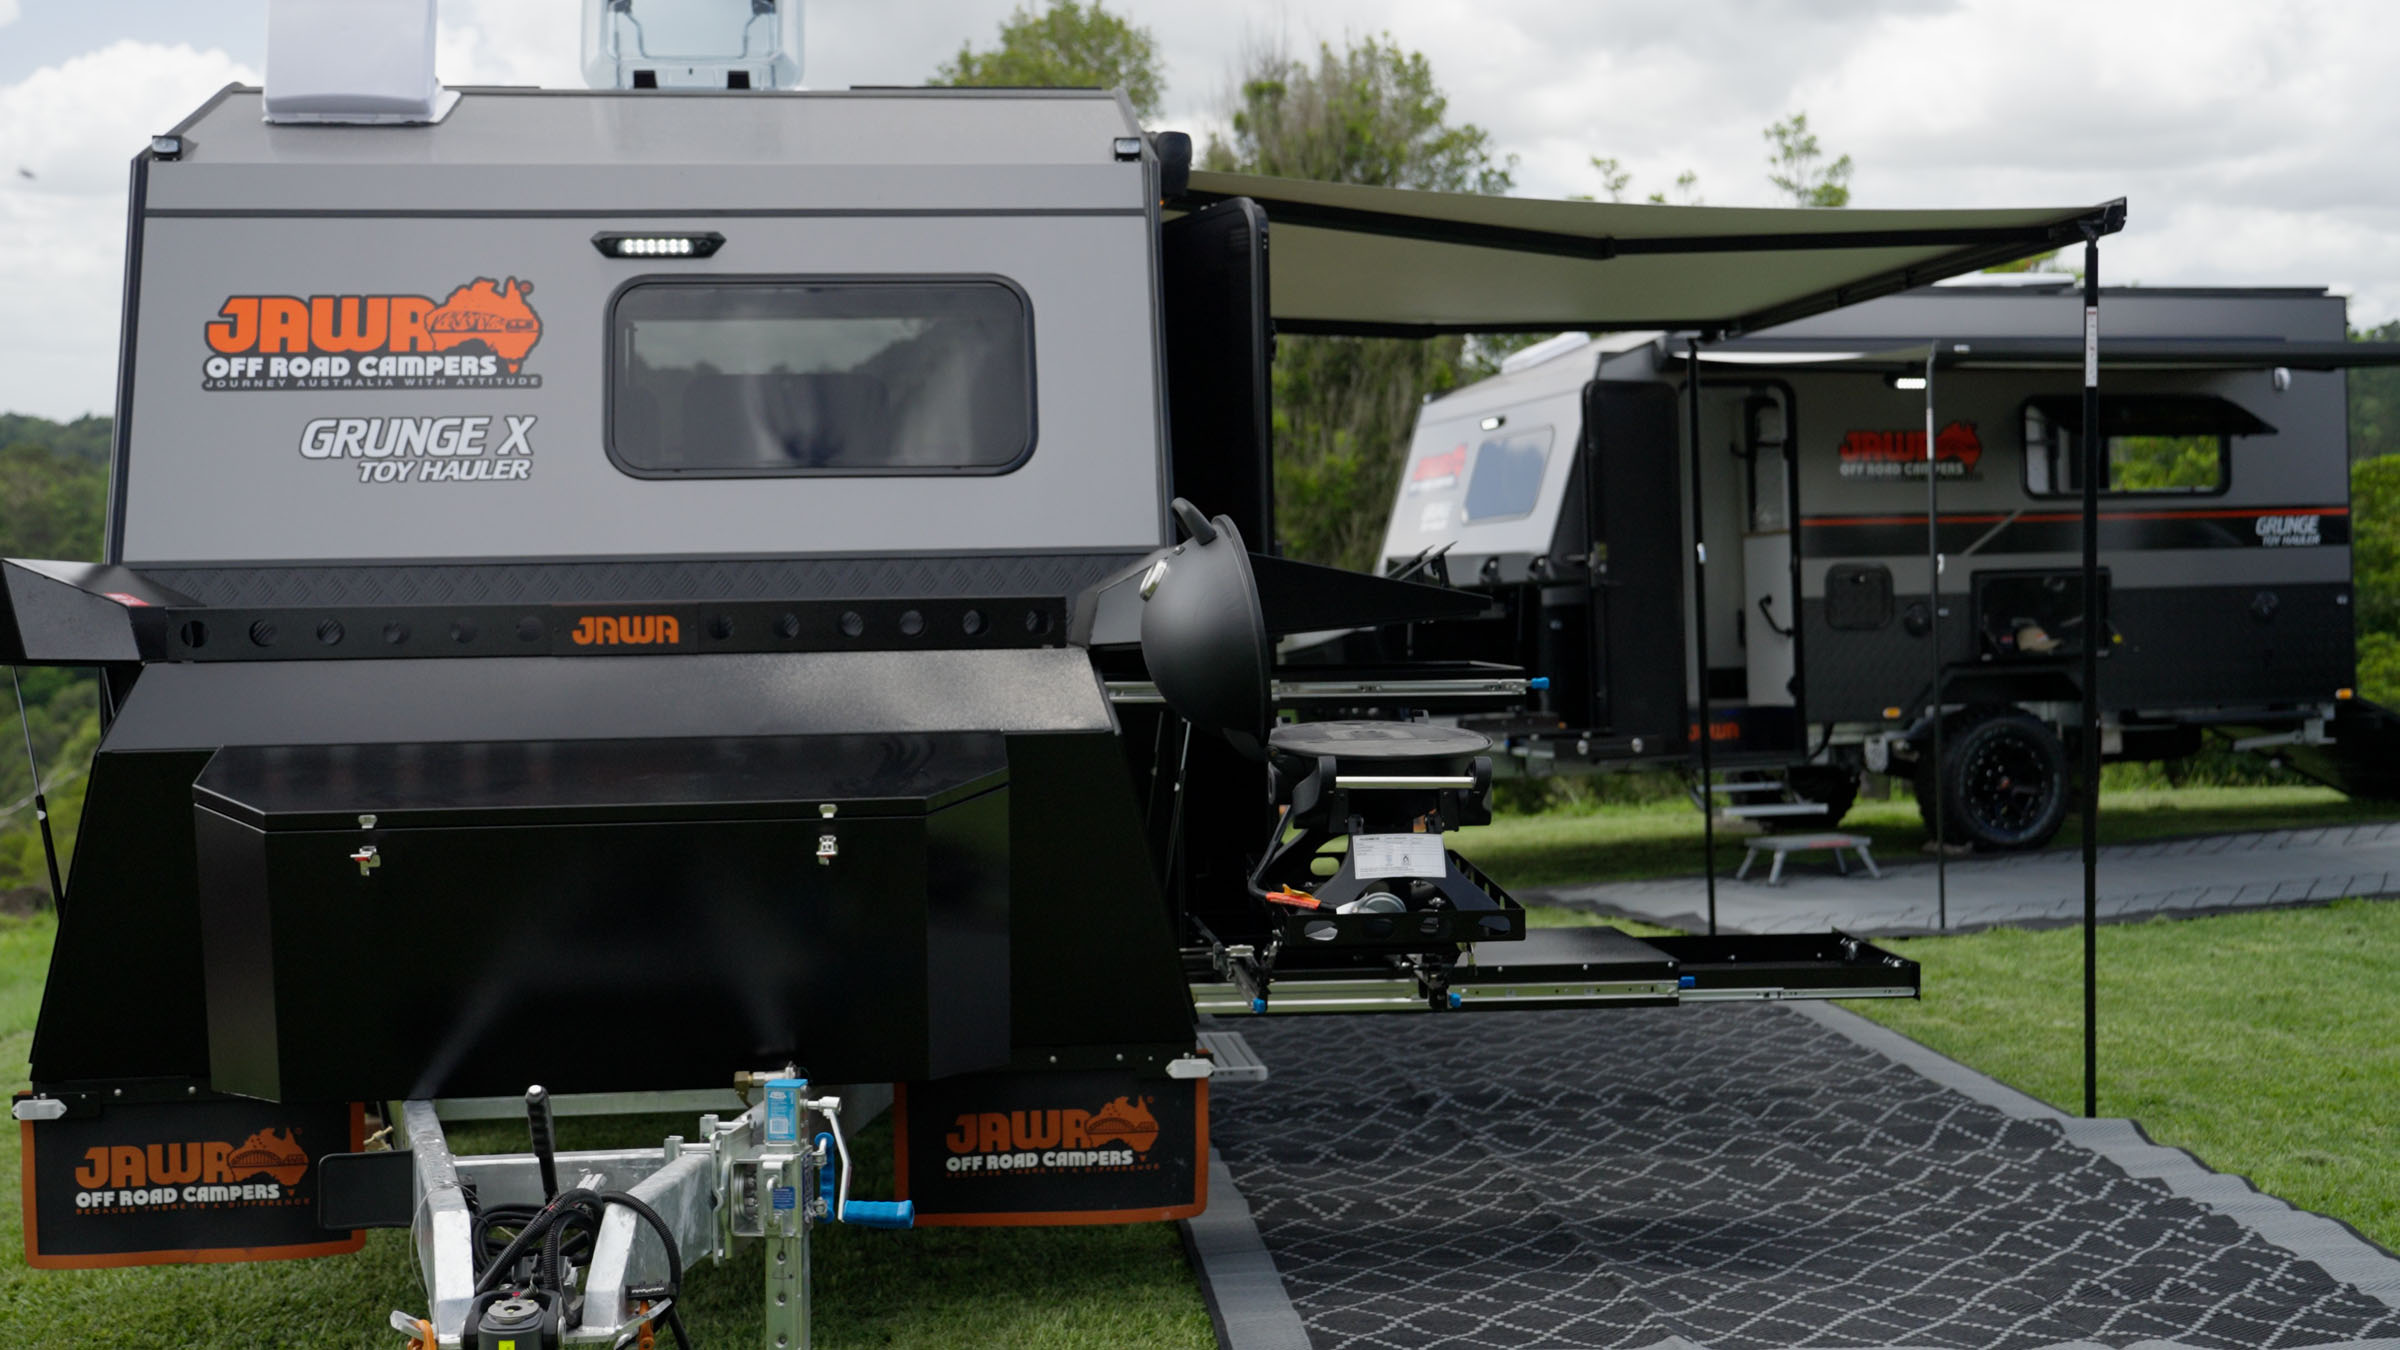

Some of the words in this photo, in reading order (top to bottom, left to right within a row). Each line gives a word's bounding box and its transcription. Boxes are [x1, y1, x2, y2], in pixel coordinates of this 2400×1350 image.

[206, 296, 437, 354] JAWA
[205, 355, 265, 379] OFF
[269, 355, 351, 378] ROAD
[357, 354, 498, 378] CAMPERS
[204, 378, 287, 388] JOURNEY
[296, 378, 394, 388] AUSTRALIA
[404, 377, 446, 387] WITH
[456, 376, 539, 387] ATTITUDE
[300, 417, 492, 459] GRUNGE
[497, 415, 537, 456] X
[358, 460, 415, 483] TOY
[418, 459, 531, 481] HAULER
[2255, 515, 2321, 536] GRUNGE
[572, 615, 680, 645] JAWA
[1688, 723, 1740, 741] JWA
[946, 1109, 1091, 1154] JAWA
[75, 1142, 235, 1189] JAWA
[946, 1156, 983, 1172] OFF
[986, 1152, 1039, 1170] ROAD
[1042, 1150, 1134, 1167] CAMPERS
[75, 1191, 115, 1208] OFF
[119, 1187, 178, 1206] ROAD
[182, 1184, 280, 1203] CAMPERS
